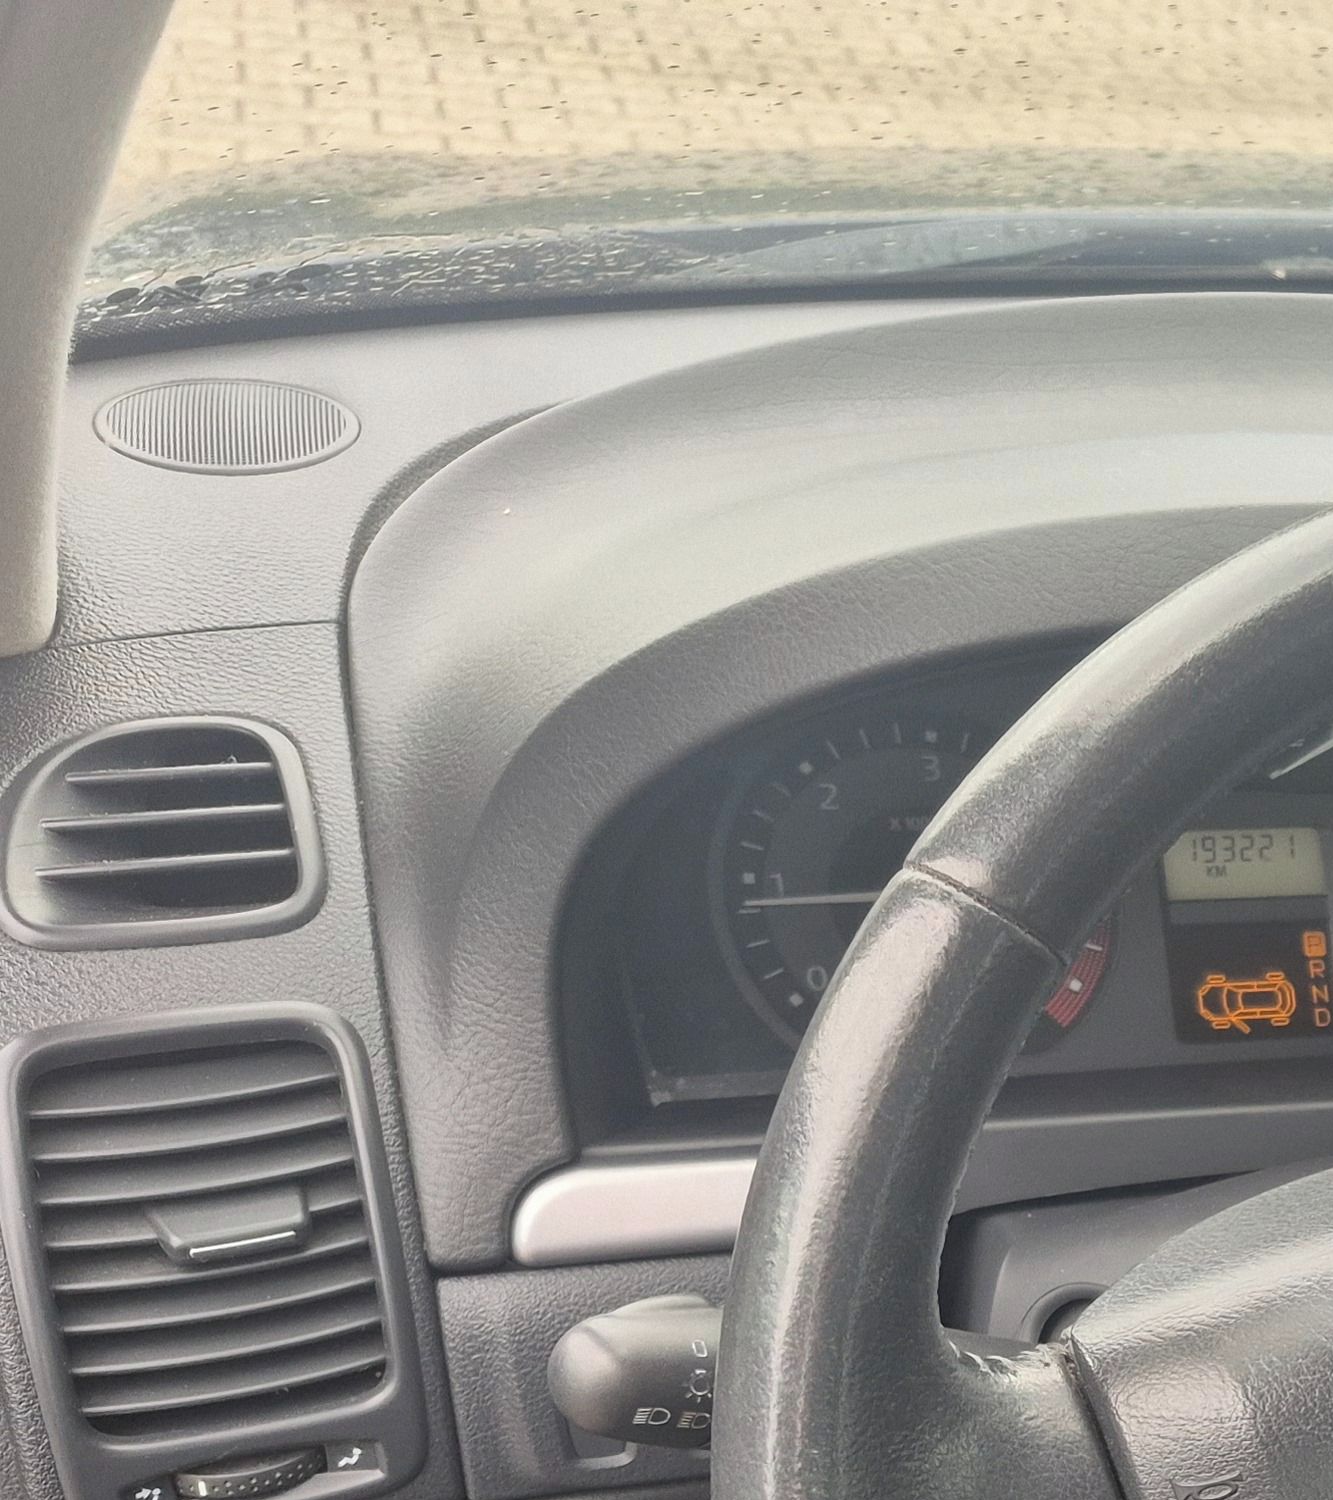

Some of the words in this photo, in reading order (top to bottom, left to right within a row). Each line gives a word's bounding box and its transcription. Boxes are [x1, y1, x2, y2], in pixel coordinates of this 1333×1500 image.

[923, 755, 940, 782] 3
[820, 783, 840, 811] 2
[1190, 833, 1295, 864] 193221
[806, 965, 829, 992] 0
[1308, 959, 1326, 979] R
[1311, 983, 1330, 1004] N
[1314, 1008, 1332, 1028] D
